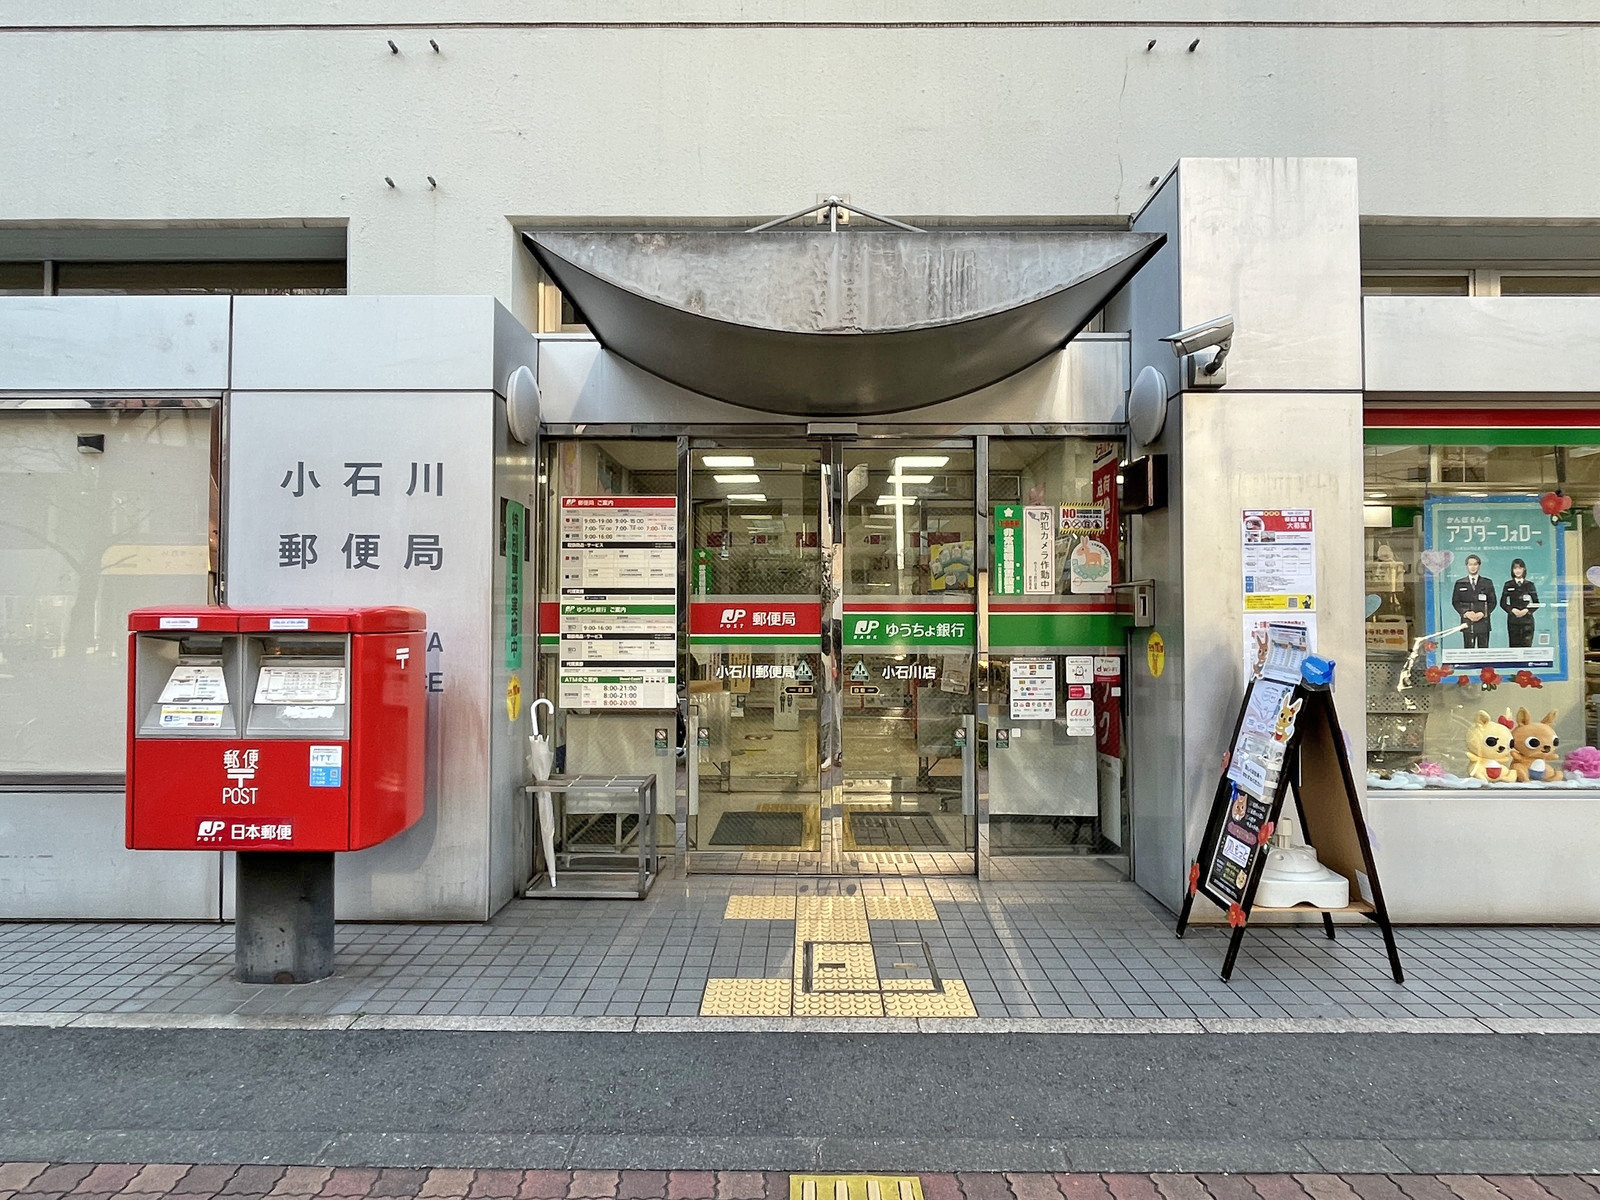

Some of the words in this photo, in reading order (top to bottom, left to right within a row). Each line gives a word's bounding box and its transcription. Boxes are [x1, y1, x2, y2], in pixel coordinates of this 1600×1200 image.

[280, 461, 443, 498] 小石川
[1062, 508, 1076, 518] NO
[1446, 524, 1541, 542] アフターフォロー
[279, 533, 443, 570] 郵便局
[1040, 511, 1050, 589] 防犯カメラ作動中
[752, 612, 796, 626] 郵便局
[886, 623, 965, 638] ゆうちょ銀行
[716, 665, 796, 679] 小石川郵便局
[882, 665, 936, 680] 小石川店
[1070, 708, 1090, 716] au
[224, 750, 260, 769] 郵便
[222, 788, 258, 804] POST
[231, 824, 292, 840] 日本郵便
